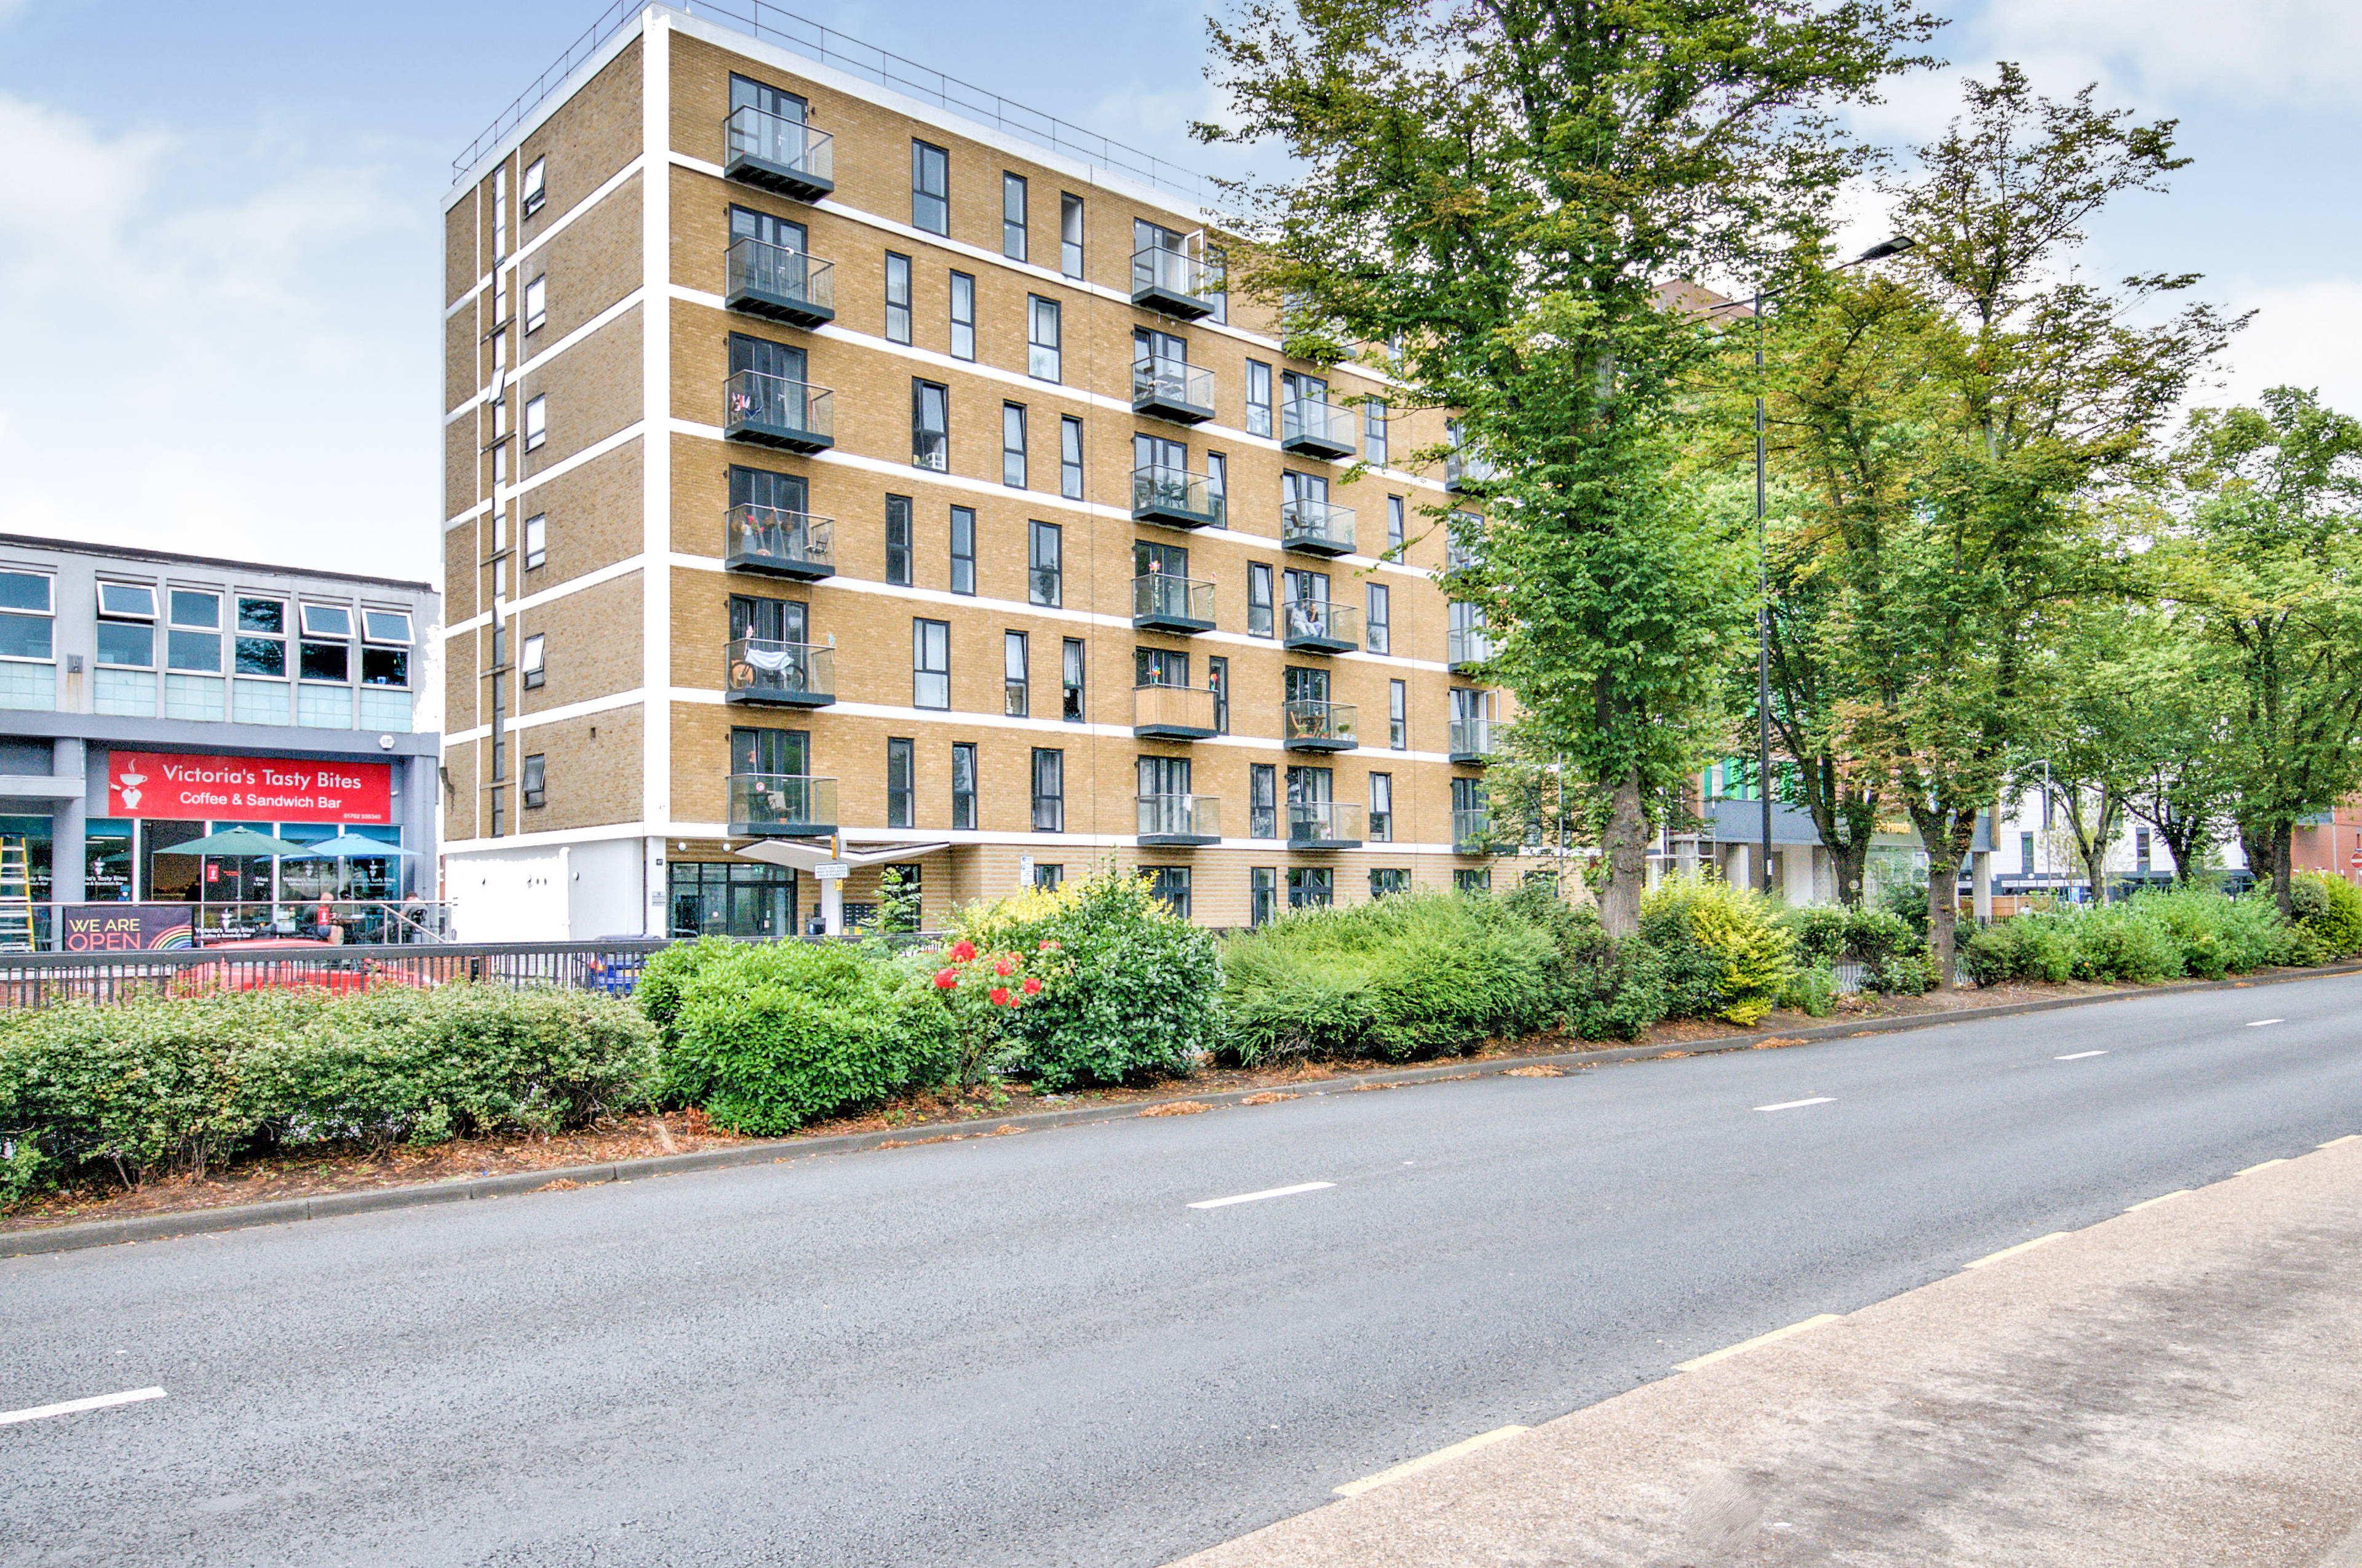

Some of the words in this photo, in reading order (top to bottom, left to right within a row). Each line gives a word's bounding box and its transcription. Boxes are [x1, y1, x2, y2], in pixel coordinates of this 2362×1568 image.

[162, 765, 255, 785] Victoria's
[262, 769, 311, 790] Tasty
[317, 771, 362, 789] Bites
[180, 791, 228, 805] Coffee
[231, 792, 242, 805] &
[247, 794, 314, 808] Sandwich
[318, 797, 342, 808] Bar
[69, 919, 101, 932] WE
[104, 918, 141, 932] ARE
[68, 932, 141, 951] OPEN
